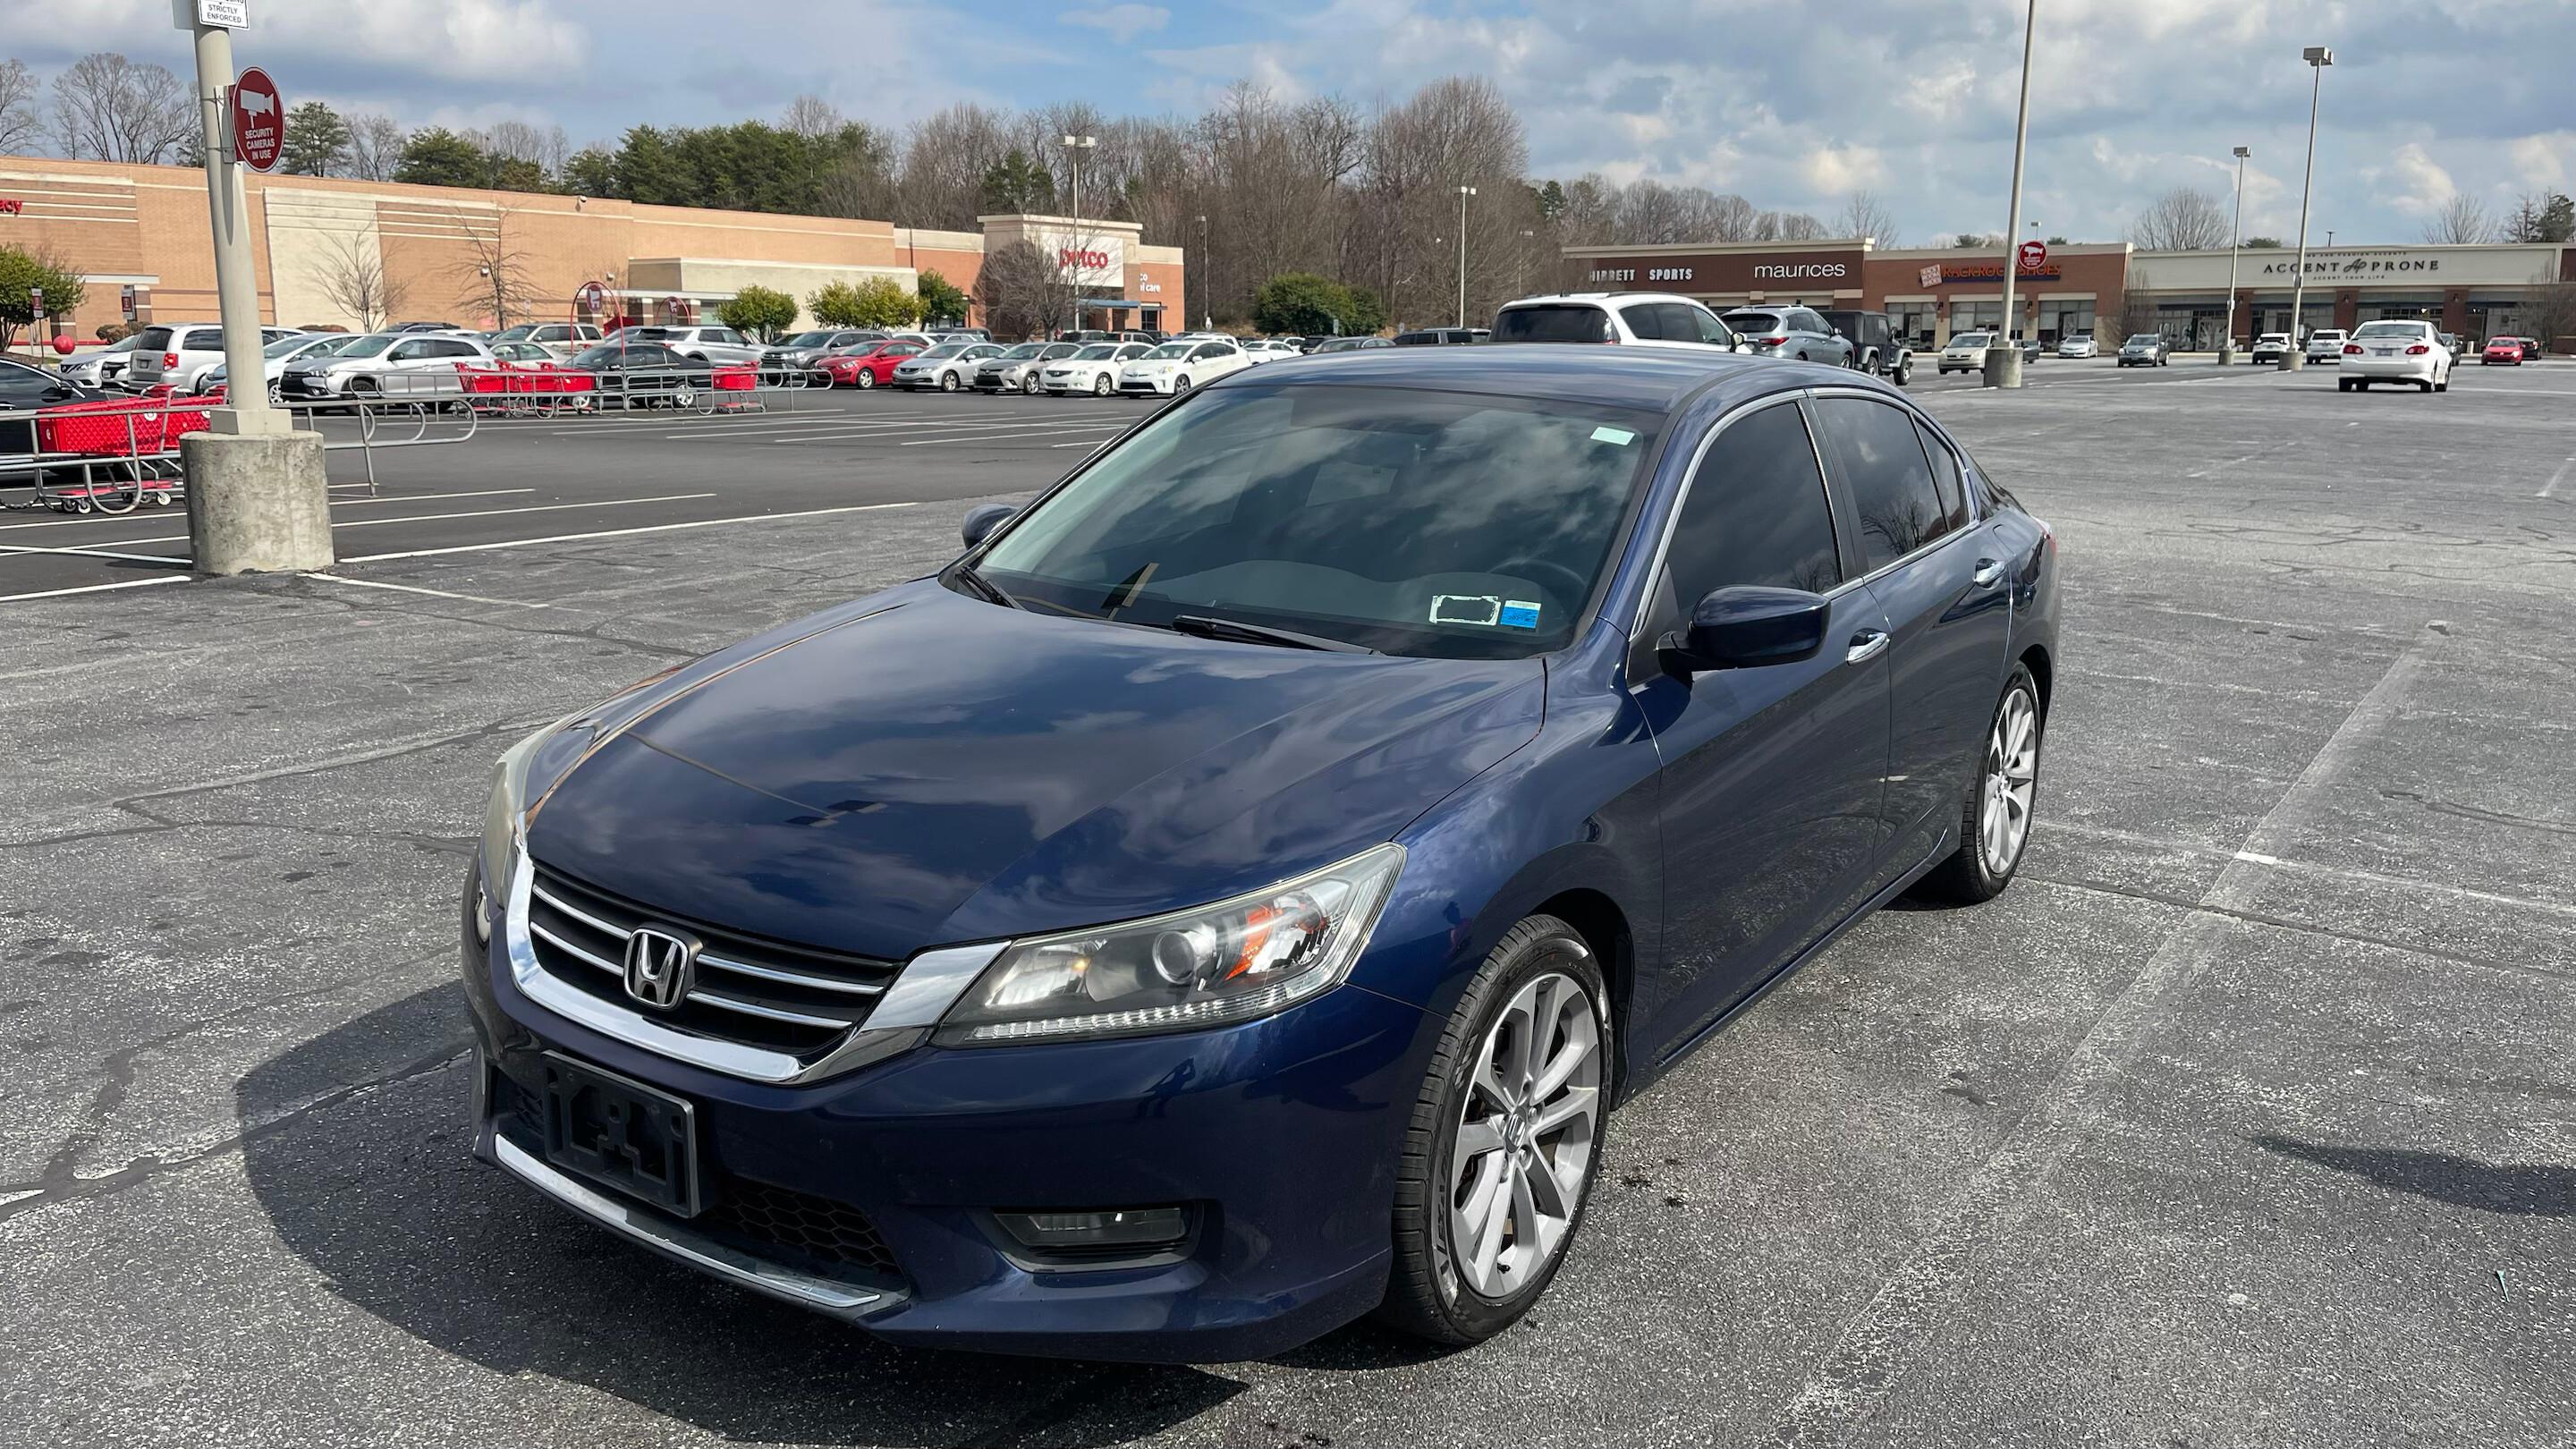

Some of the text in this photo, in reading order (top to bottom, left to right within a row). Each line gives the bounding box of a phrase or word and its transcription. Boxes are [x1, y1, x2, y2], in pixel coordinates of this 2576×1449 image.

[208, 4, 238, 14] STRICTLY
[207, 13, 242, 23] ENFORCED
[245, 127, 274, 140] SECURITY
[246, 138, 275, 150] CAMERAS
[251, 149, 272, 160] IN USE
[1754, 264, 1846, 278] maurices
[1943, 266, 1976, 278] RACK
[1978, 265, 2005, 277] ROO
[2263, 263, 2340, 274] ACCENT
[2371, 259, 2440, 272] PRONE
[1648, 268, 1693, 281] SPORTS
[1146, 284, 1161, 292] care
